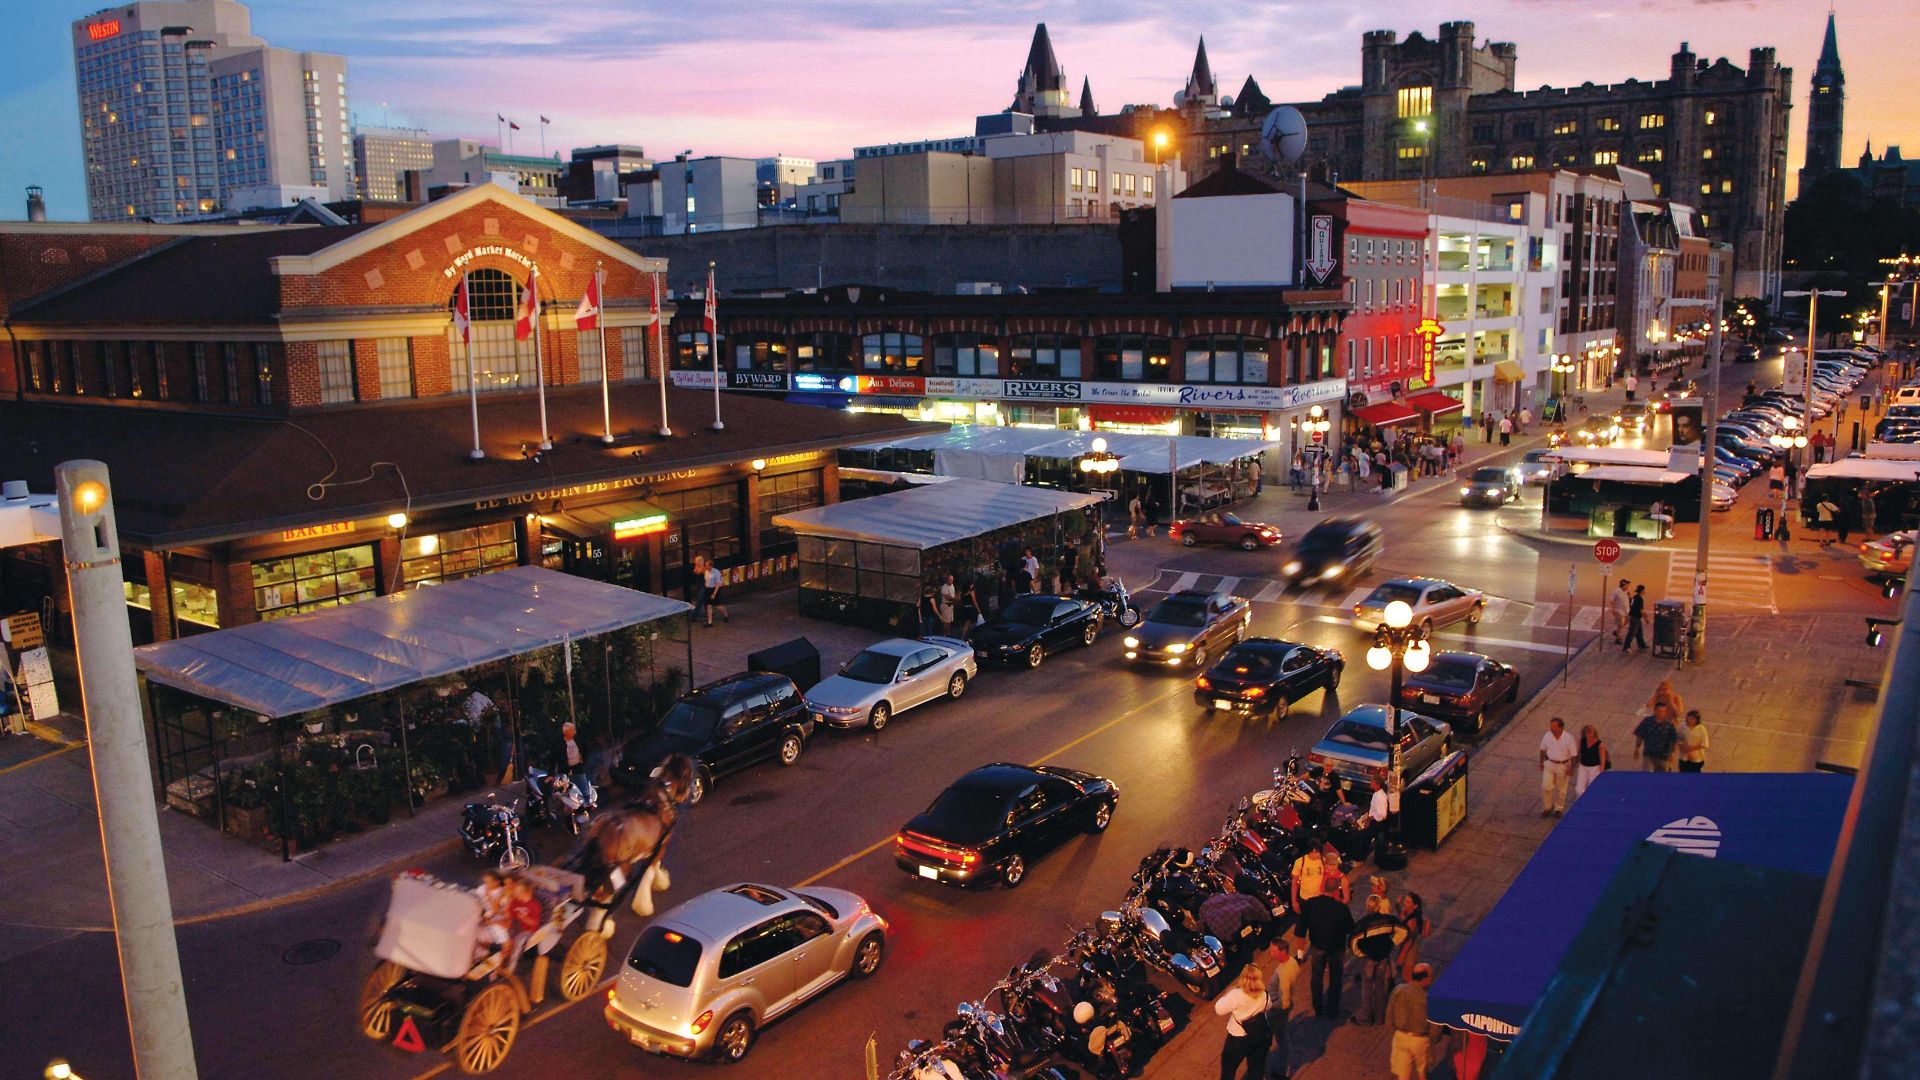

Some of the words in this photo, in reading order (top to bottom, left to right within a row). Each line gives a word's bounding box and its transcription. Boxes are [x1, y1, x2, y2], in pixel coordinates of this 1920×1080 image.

[89, 20, 120, 40] WESTIN
[474, 245, 503, 257] Market
[736, 373, 782, 384] BYWARD
[869, 376, 884, 387] Aux
[1006, 382, 1080, 399] RIVERS
[1178, 386, 1245, 404] Rivers
[285, 521, 349, 539] BAKERY
[669, 534, 678, 544] 55
[592, 549, 602, 559] 55
[1596, 546, 1619, 556] STOP
[1467, 1014, 1518, 1035] LAPOINTE
